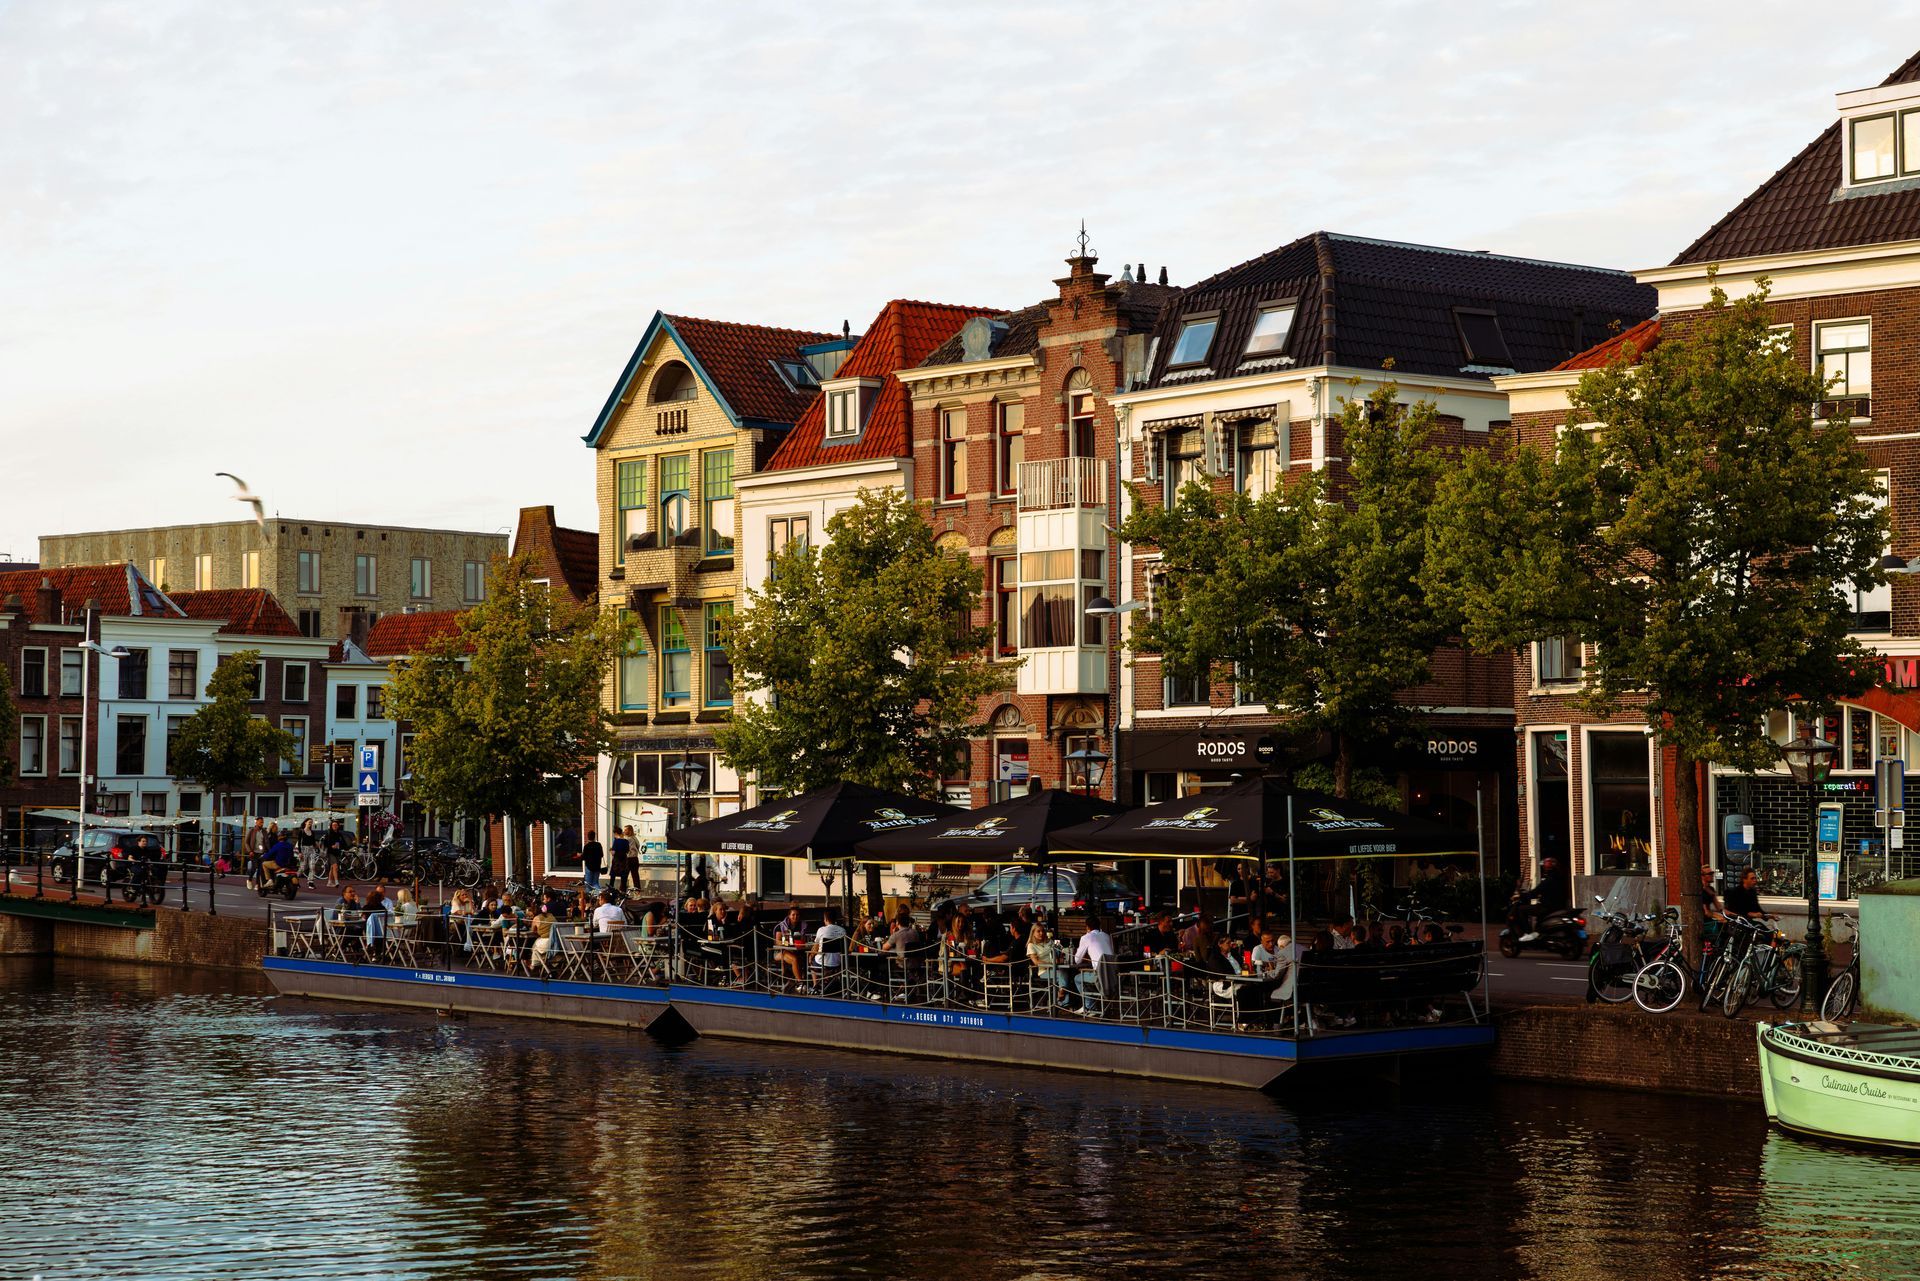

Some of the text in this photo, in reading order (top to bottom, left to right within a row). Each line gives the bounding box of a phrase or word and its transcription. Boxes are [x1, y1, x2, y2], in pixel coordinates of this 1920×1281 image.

[1197, 741, 1246, 756] RODOS
[1427, 740, 1478, 754] RODOS
[366, 752, 372, 761] P
[1349, 844, 1397, 853] UIT LIEFDE VOOR BIER
[1821, 1075, 1858, 1094] Culinaire
[1859, 1082, 1887, 1099] Cruise
